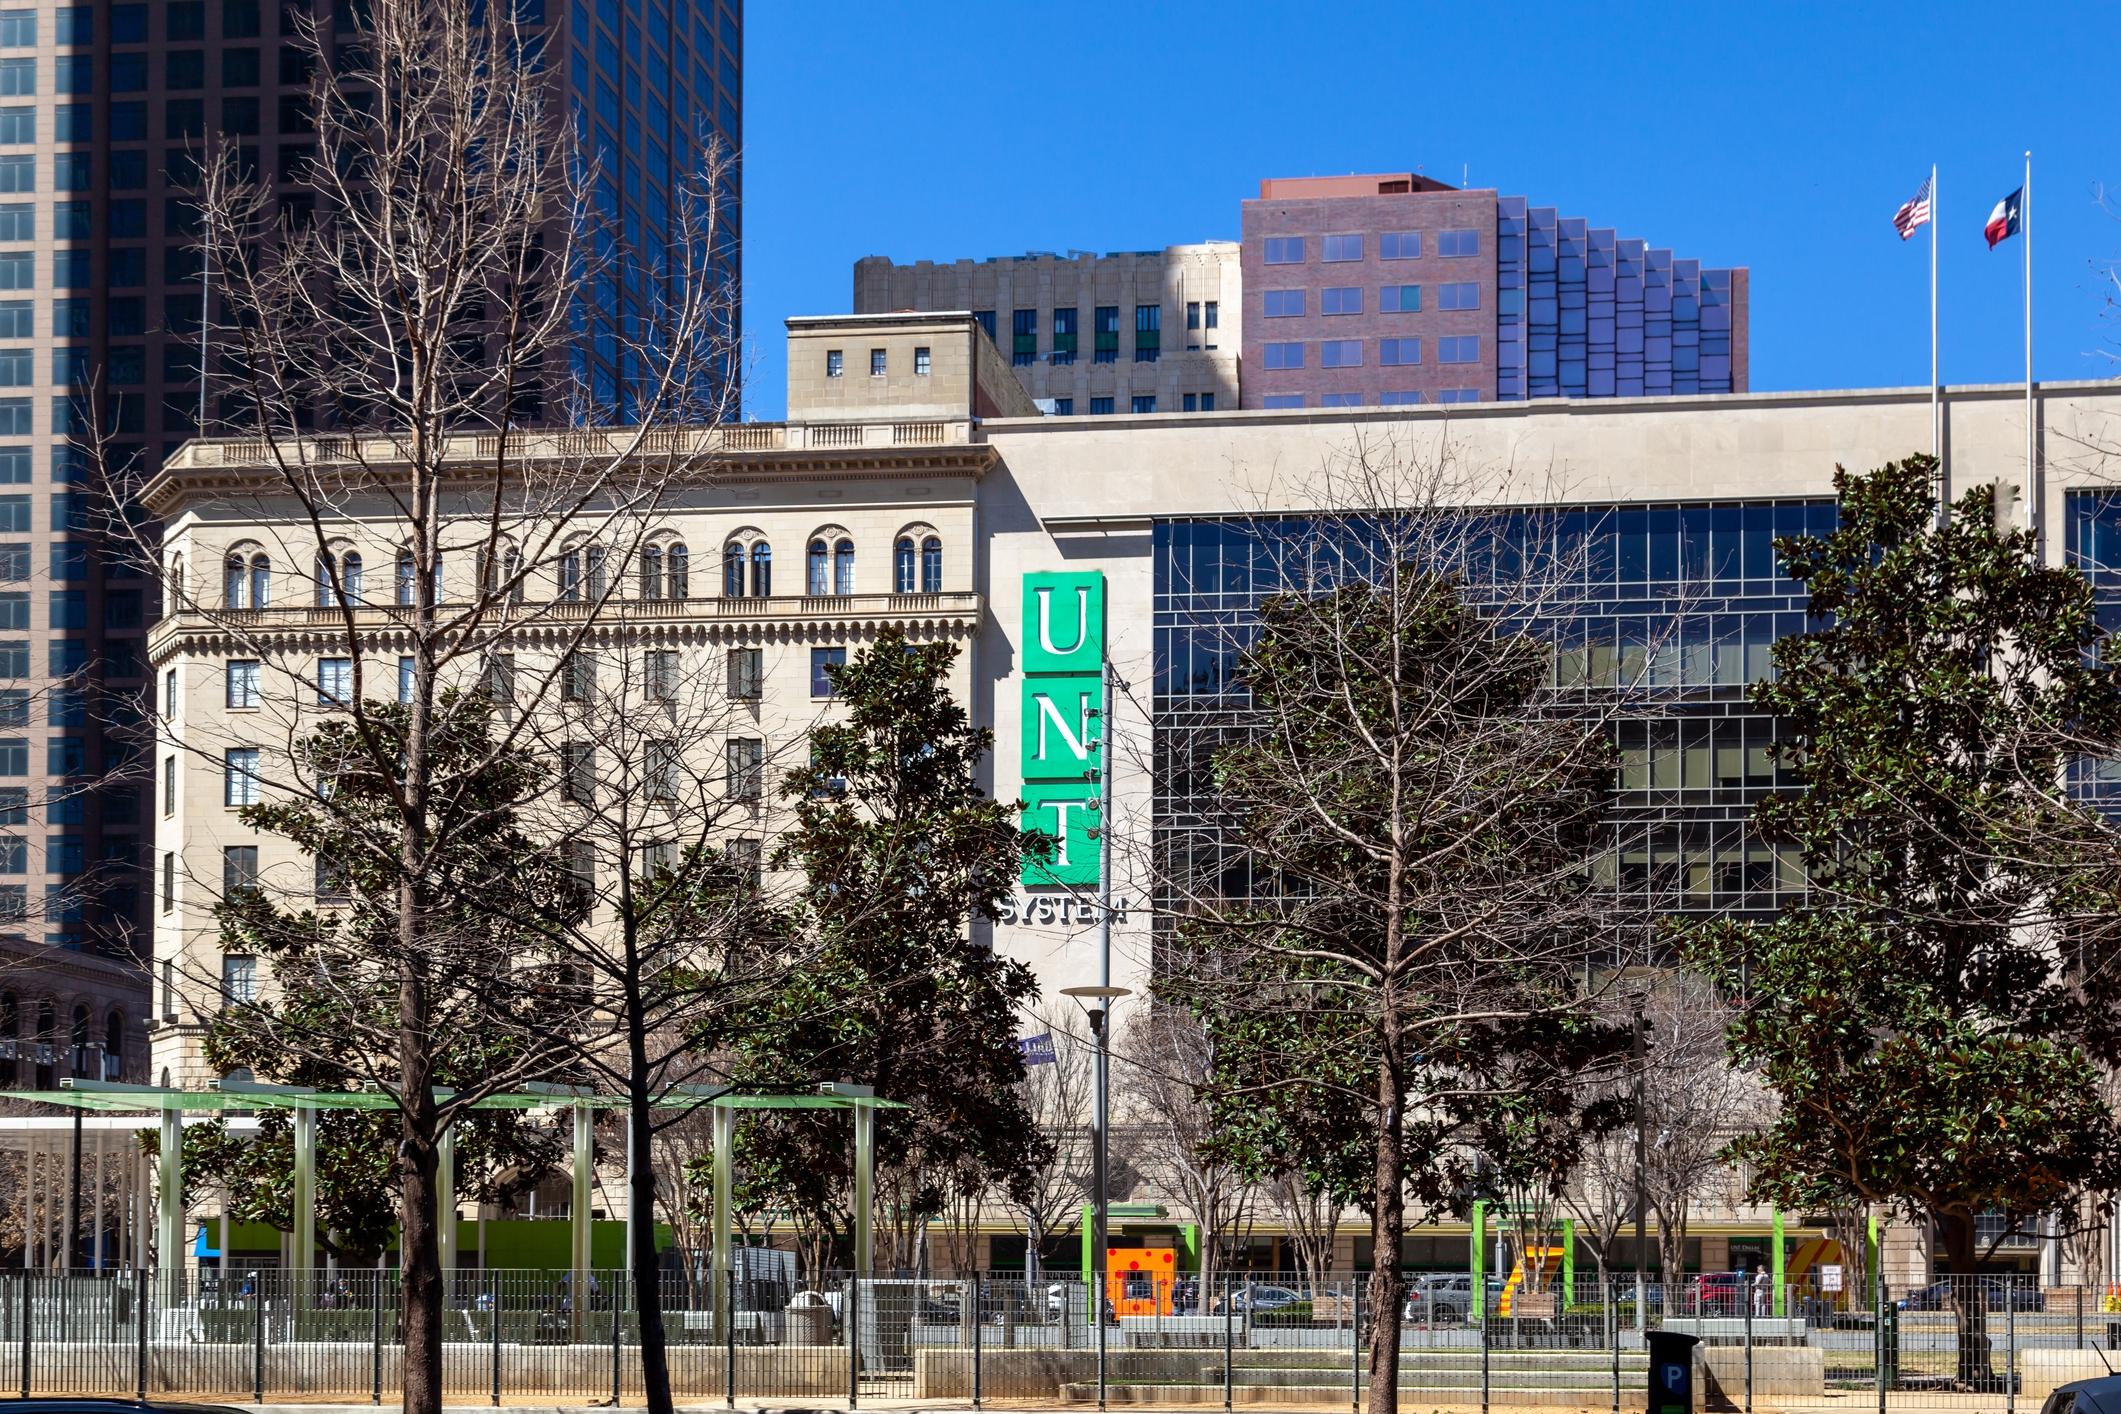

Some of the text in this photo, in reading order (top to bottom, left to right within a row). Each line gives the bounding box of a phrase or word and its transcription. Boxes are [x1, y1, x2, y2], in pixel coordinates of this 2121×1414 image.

[1032, 585, 1093, 867] UNT
[998, 894, 1125, 920] SYSTEM
[1667, 1366, 1682, 1389] P
